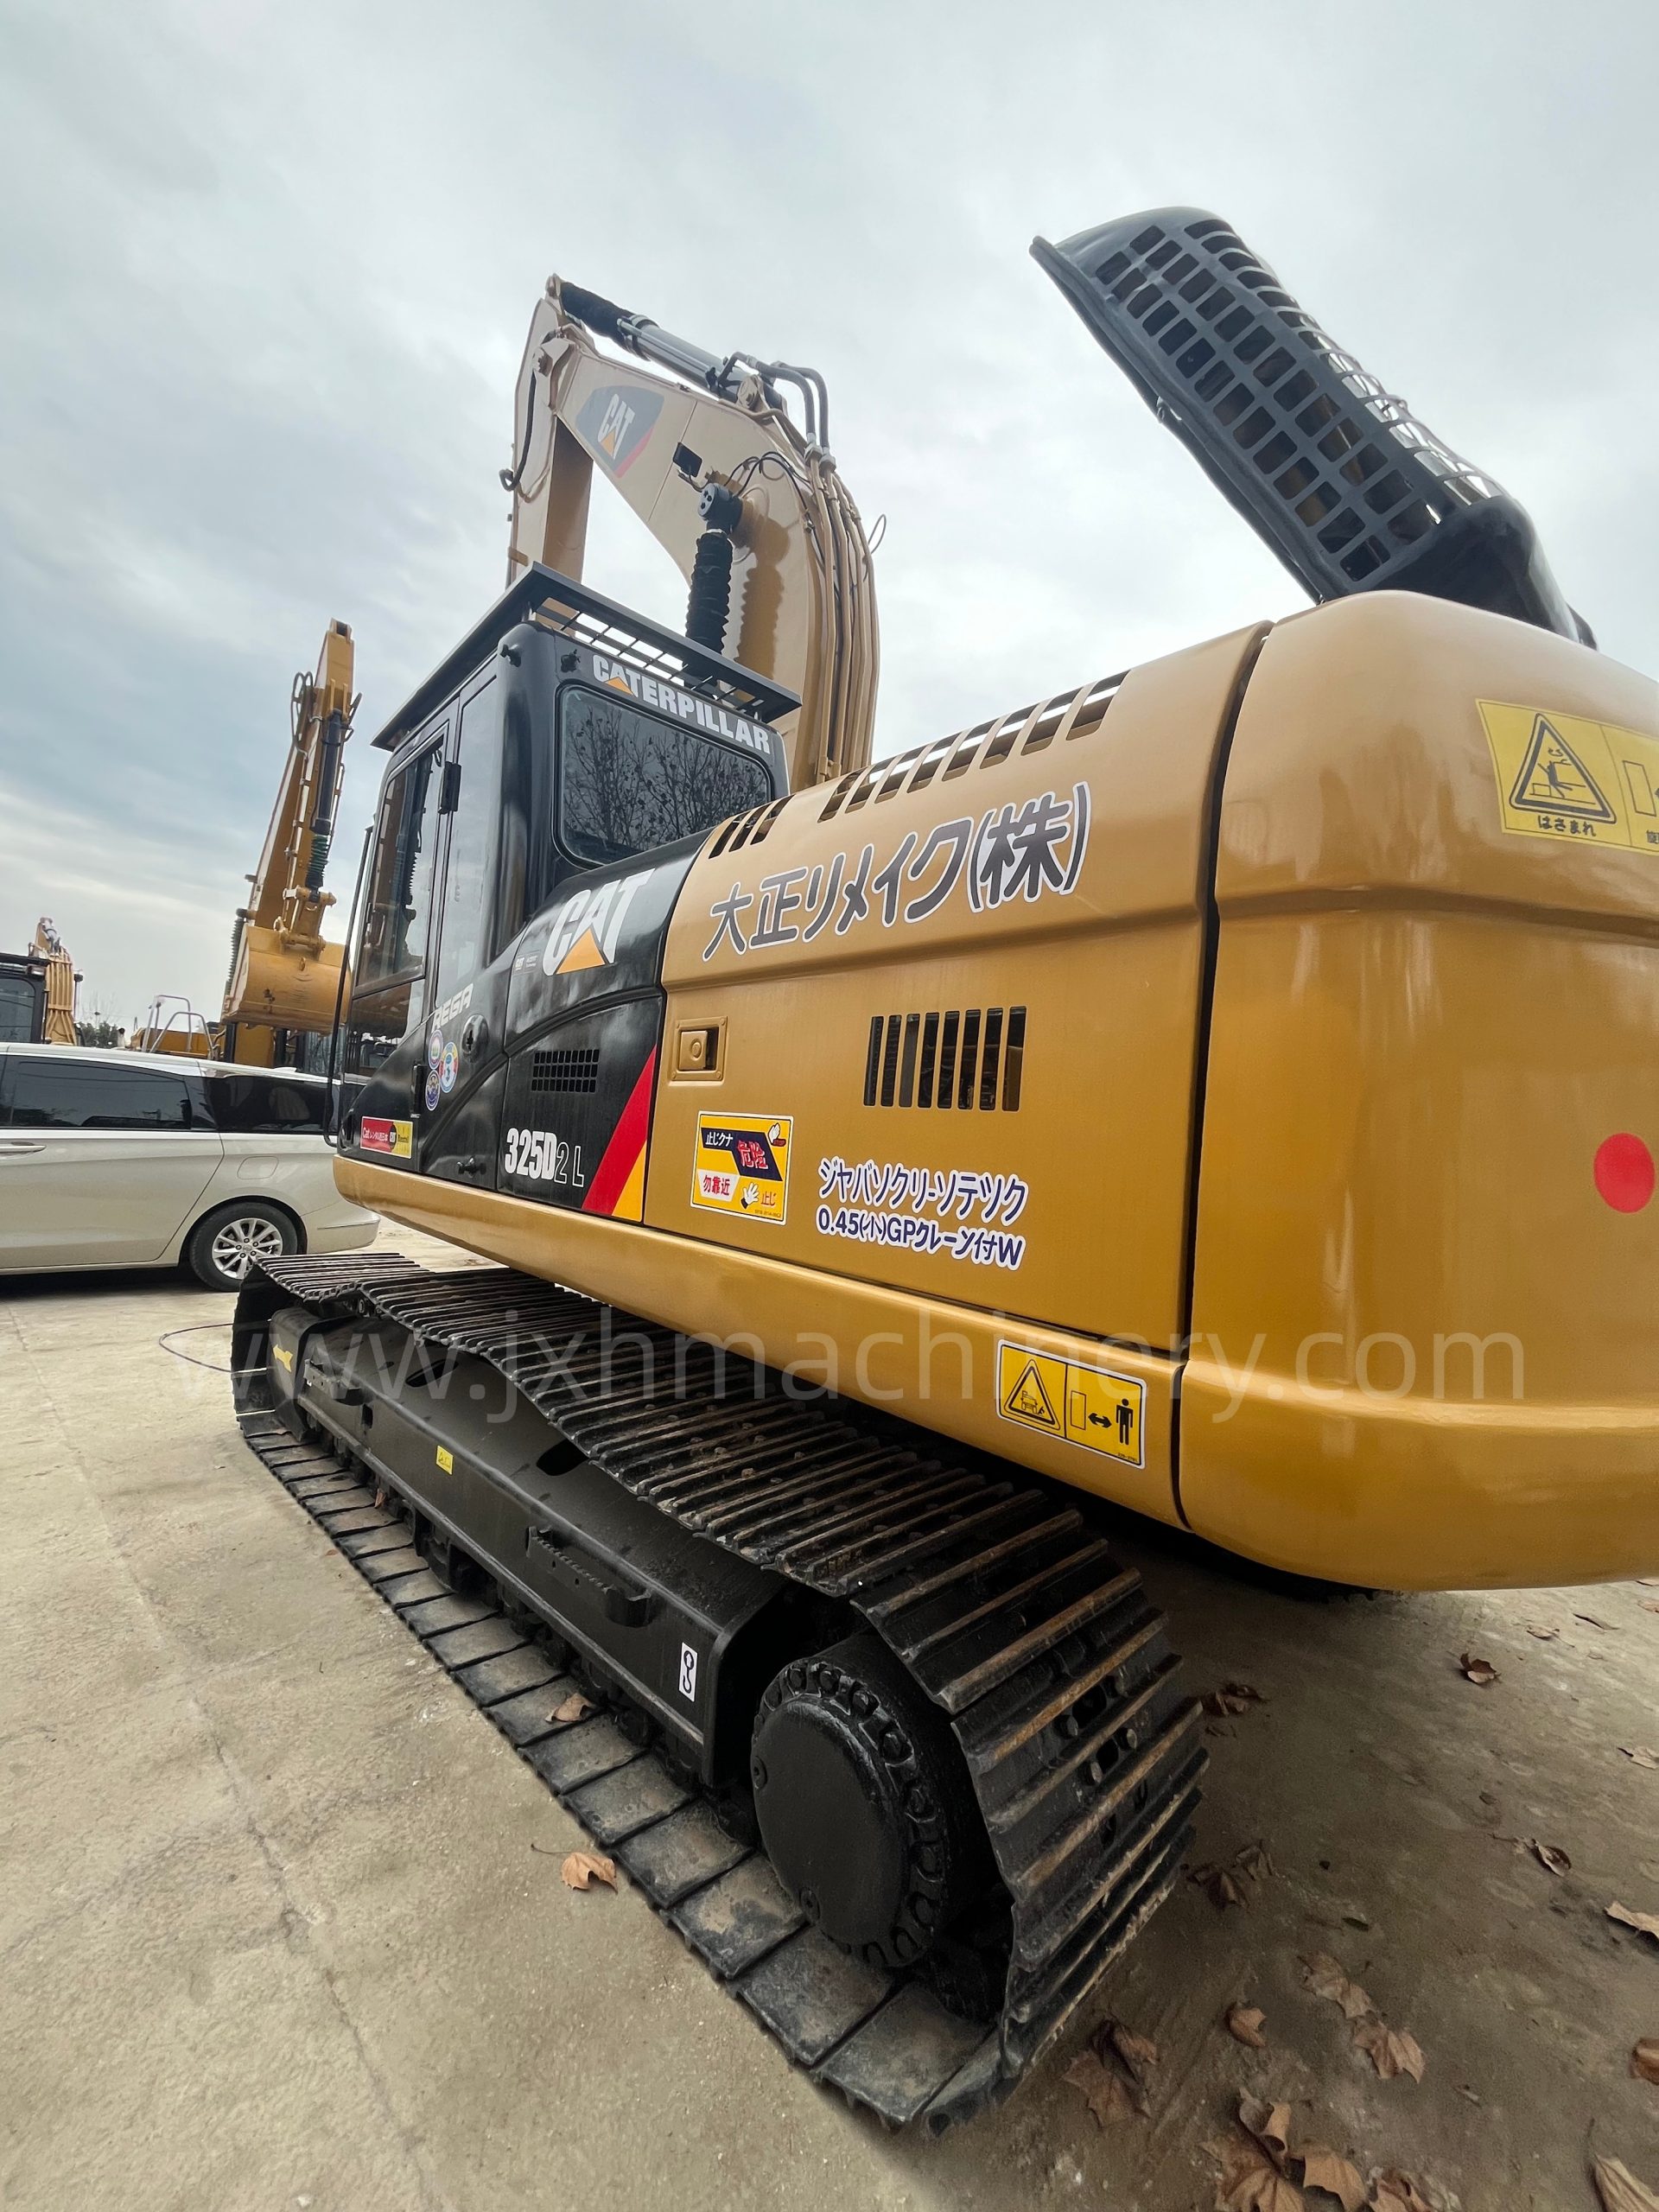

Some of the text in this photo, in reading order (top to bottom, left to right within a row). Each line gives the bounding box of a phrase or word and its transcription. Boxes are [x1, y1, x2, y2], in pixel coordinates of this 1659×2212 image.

[598, 393, 635, 460] CAT
[593, 654, 771, 754] CATERPILLAR
[1537, 815, 1597, 837] はさまれ
[543, 868, 656, 976] CAT
[703, 1175, 730, 1196] 勿靠近
